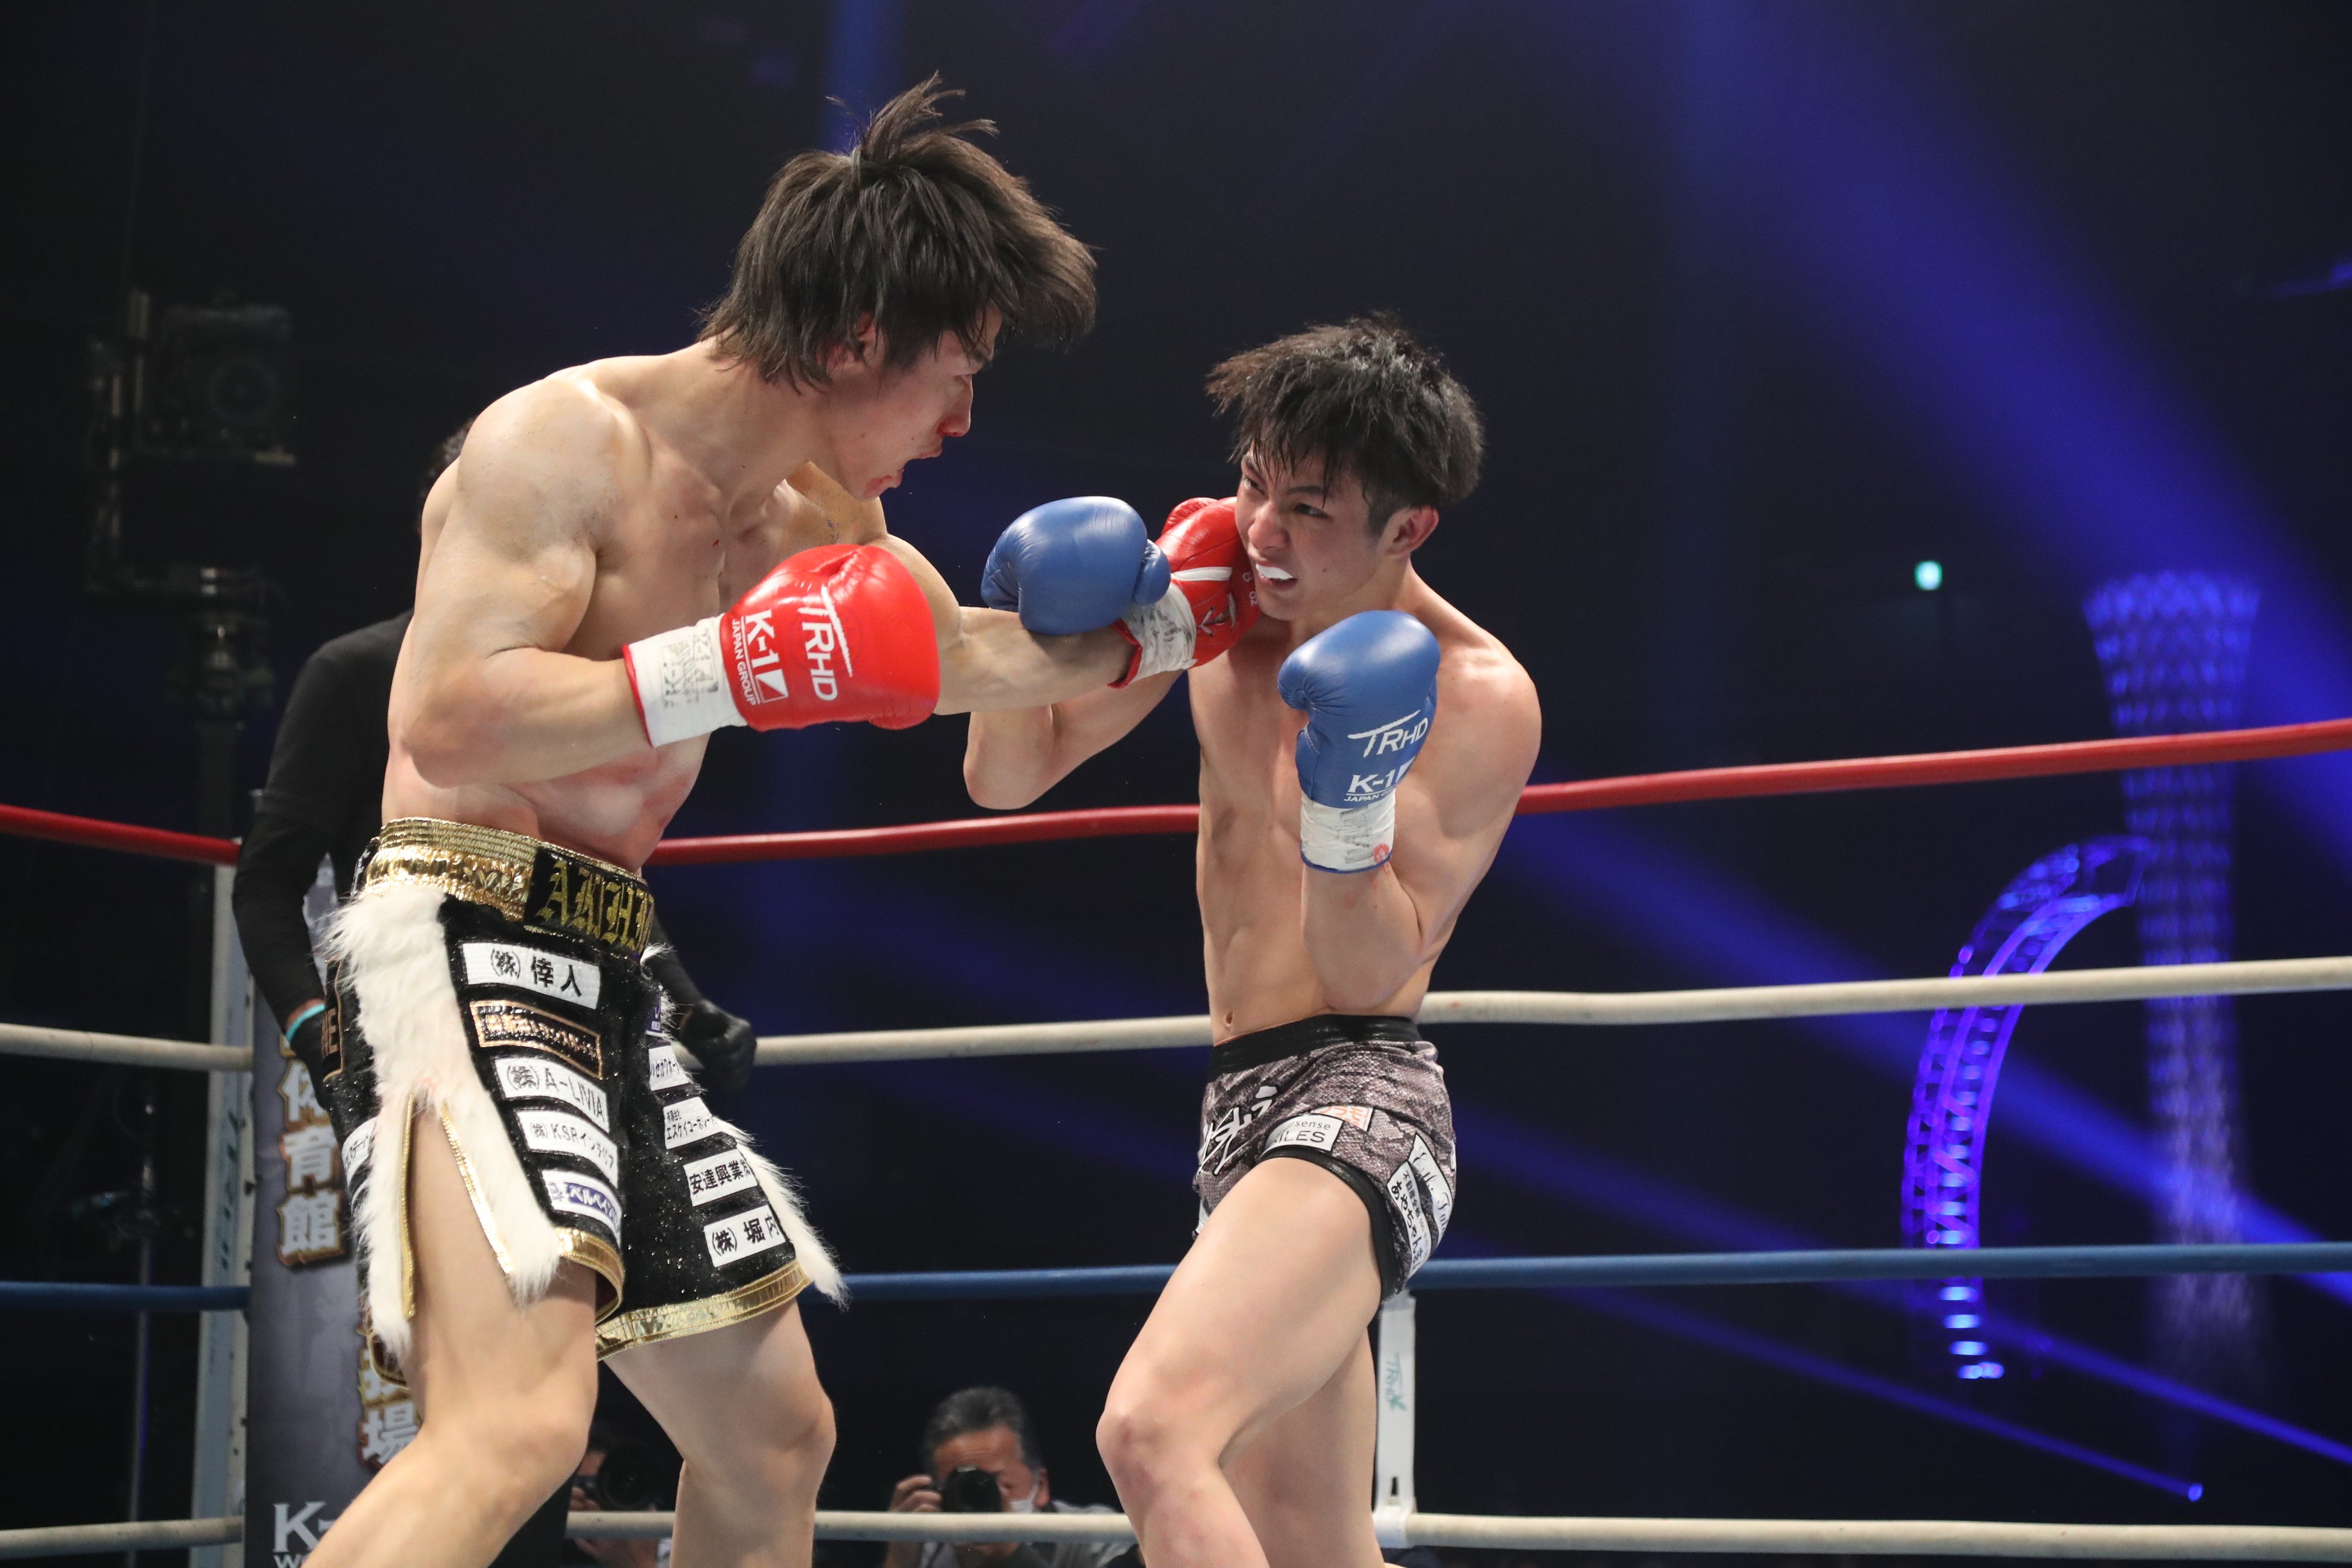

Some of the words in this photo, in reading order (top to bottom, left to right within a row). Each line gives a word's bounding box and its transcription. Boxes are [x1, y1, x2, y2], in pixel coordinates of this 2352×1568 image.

[732, 618, 745, 660] JAPAN
[745, 609, 780, 669] K-1
[797, 583, 853, 701] TRHD
[736, 661, 757, 706] GROUP
[1347, 709, 1429, 759] TRHD
[1343, 792, 1380, 802] JAPAN
[1347, 768, 1396, 793] K-1
[1294, 1120, 1332, 1131] sense
